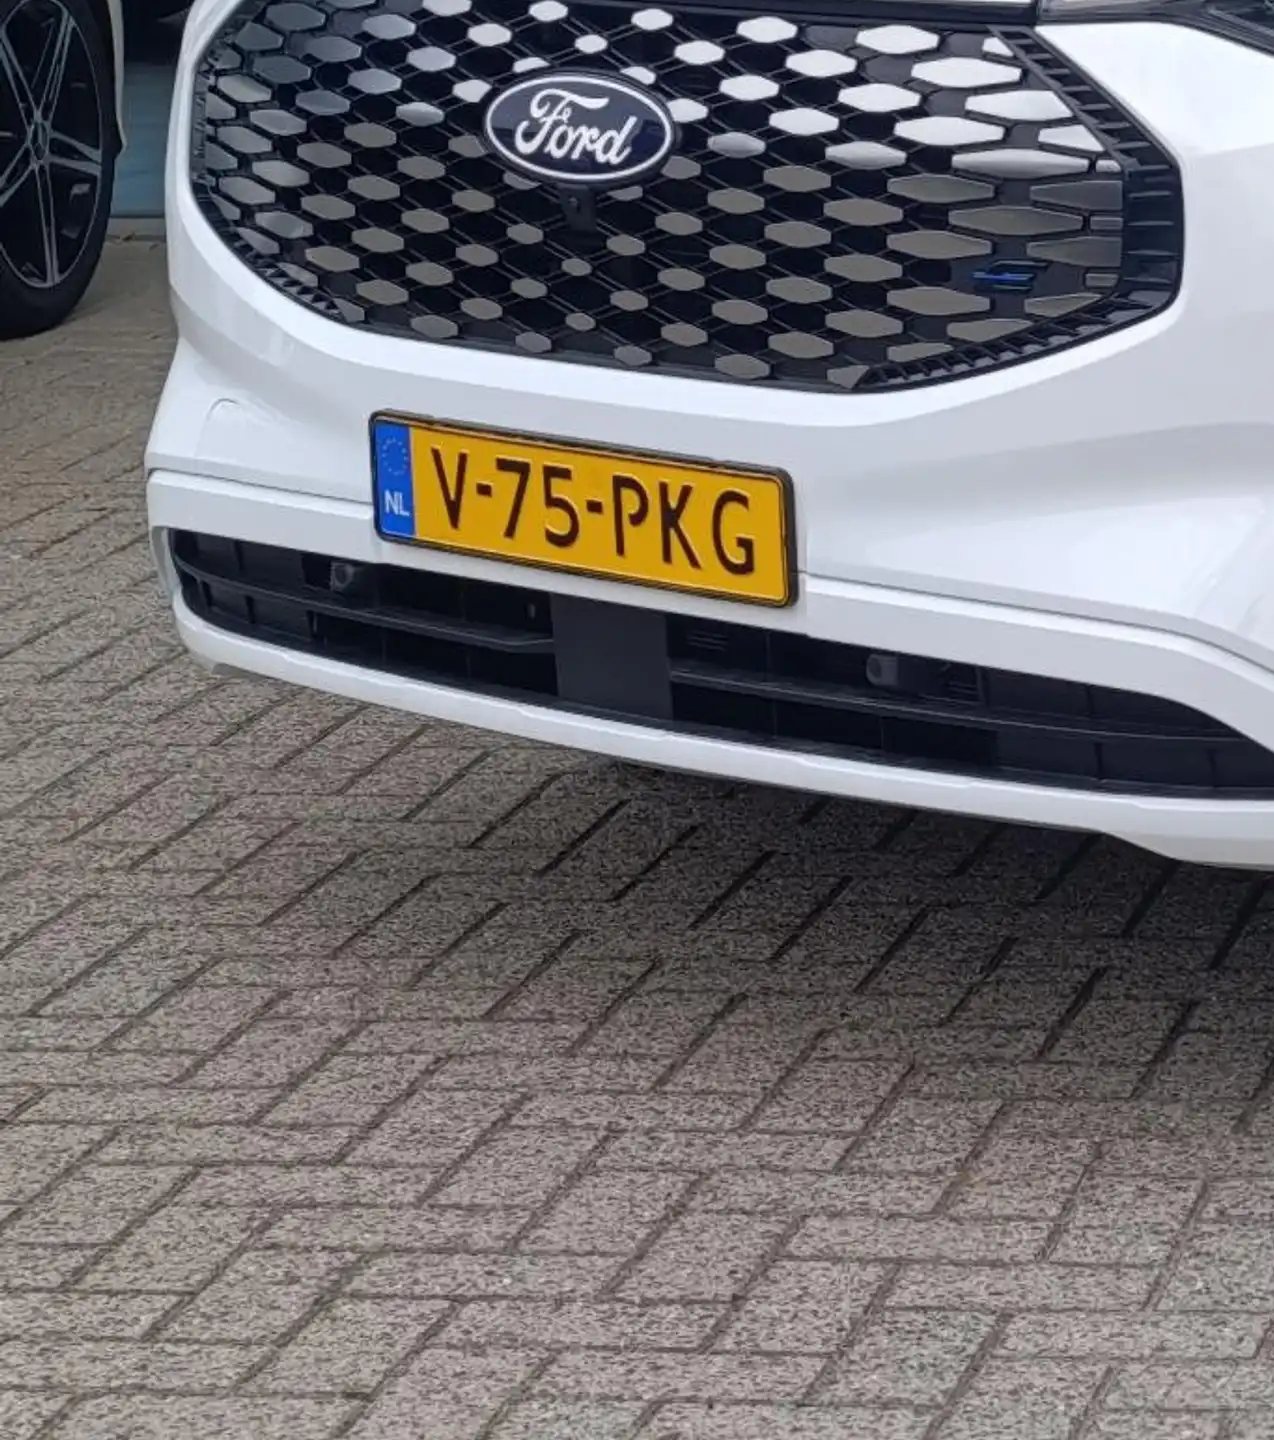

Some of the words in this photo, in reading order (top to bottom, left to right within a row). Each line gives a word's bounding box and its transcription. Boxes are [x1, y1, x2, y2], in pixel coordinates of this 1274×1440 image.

[514, 87, 638, 165] Ford
[383, 490, 411, 517] NL
[430, 446, 755, 576] V-75-PKG
